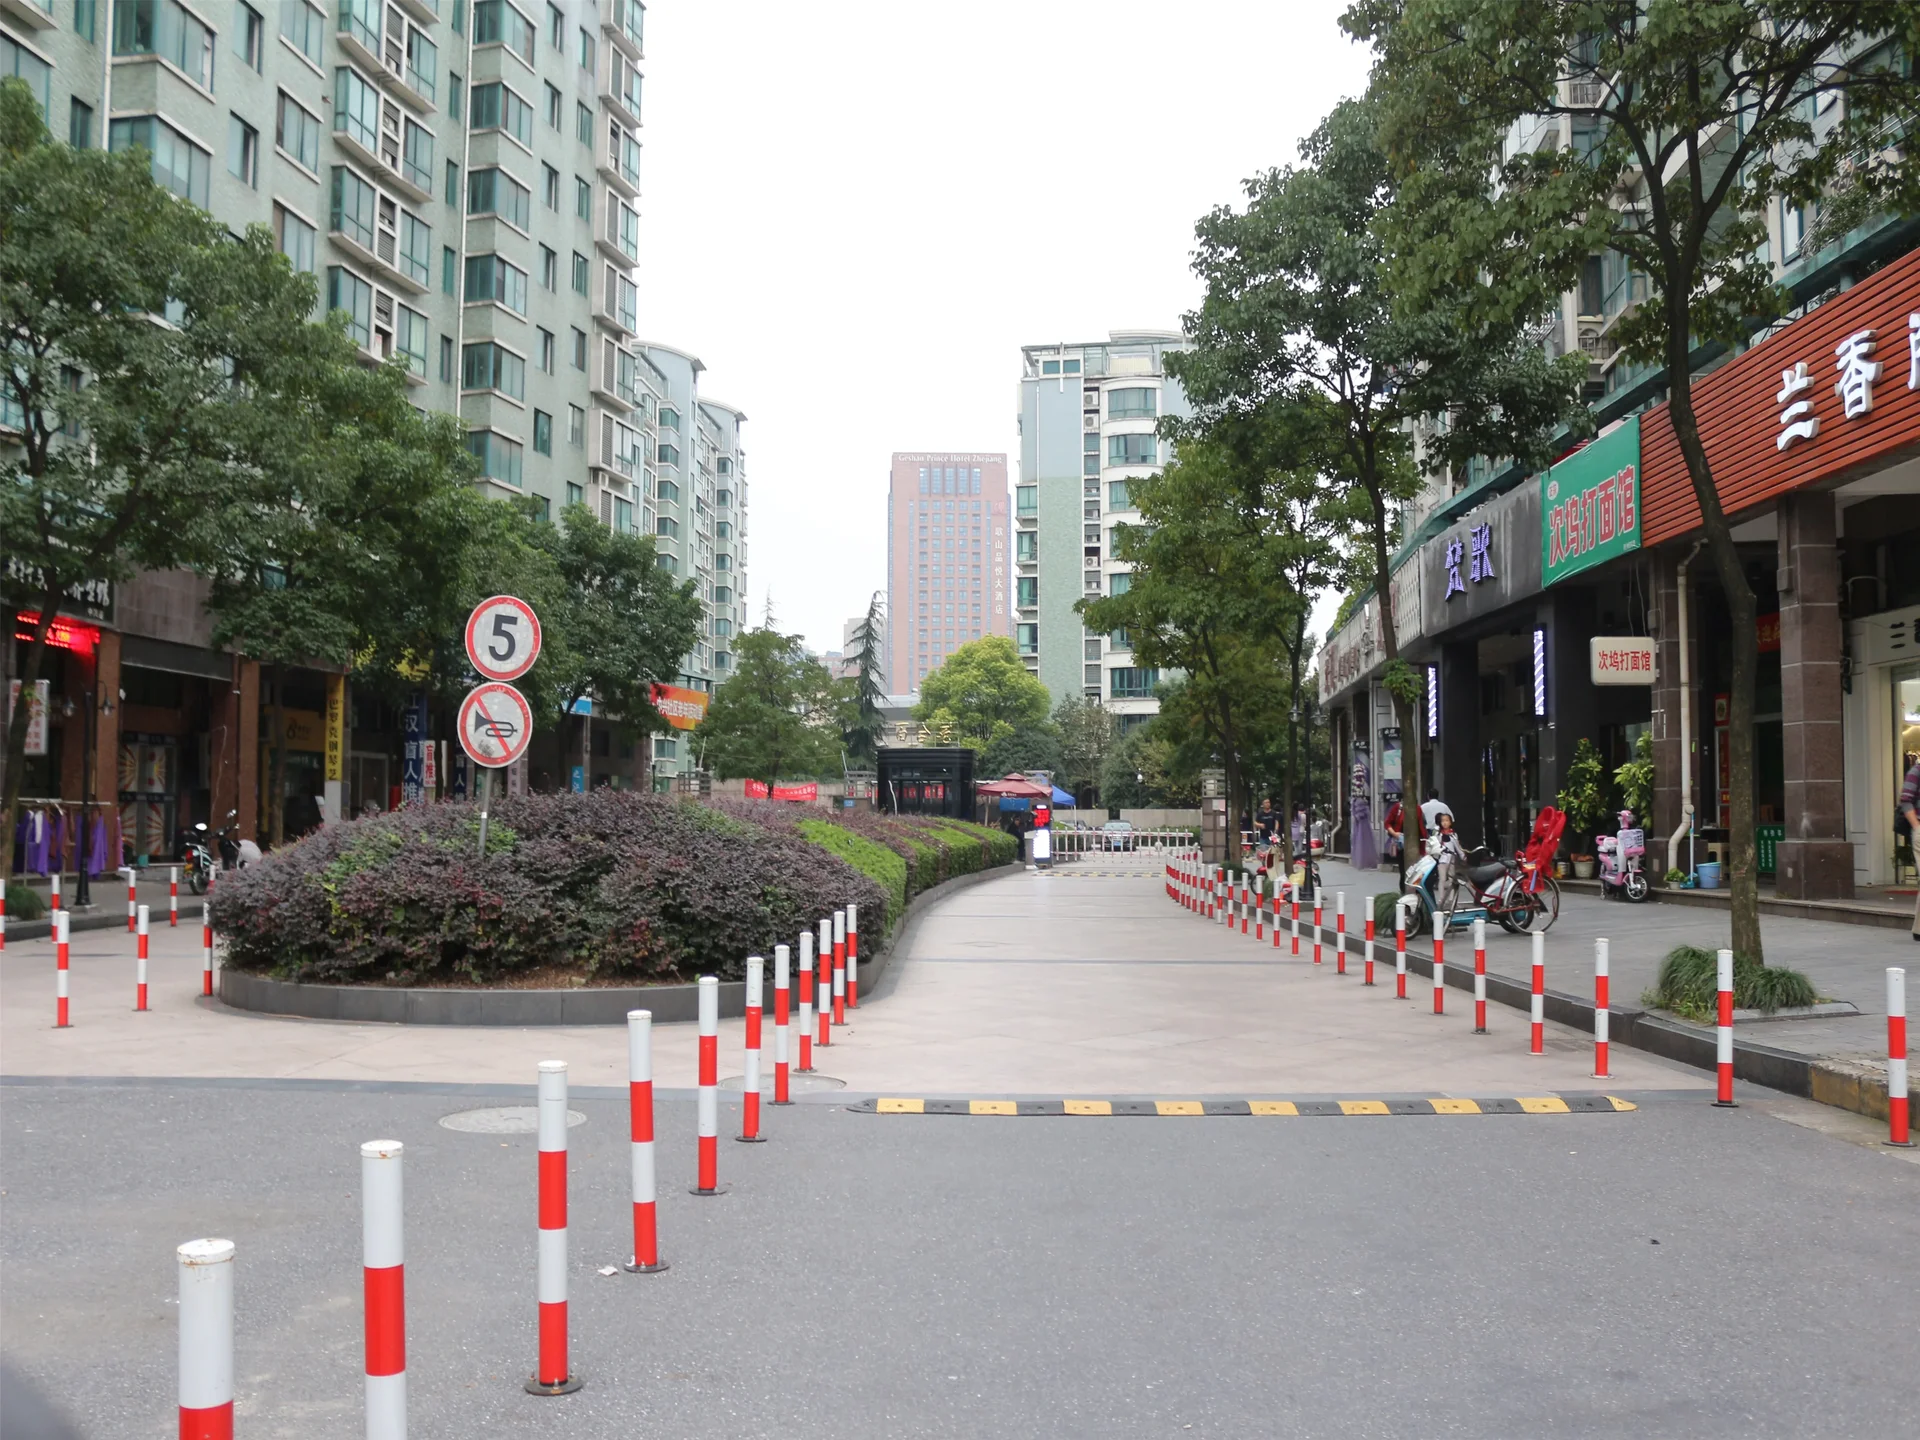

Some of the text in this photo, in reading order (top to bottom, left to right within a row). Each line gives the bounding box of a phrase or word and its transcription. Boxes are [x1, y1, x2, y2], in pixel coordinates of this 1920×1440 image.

[1776, 313, 1920, 452] 兰香
[898, 454, 1002, 464] Geshan Prince Hotel Zhejiang
[1548, 464, 1636, 568] 次坞打面馆
[994, 526, 1004, 615] 歌山品悦大酒店
[488, 613, 519, 662] 5
[1598, 650, 1651, 672] 次坞打面馆
